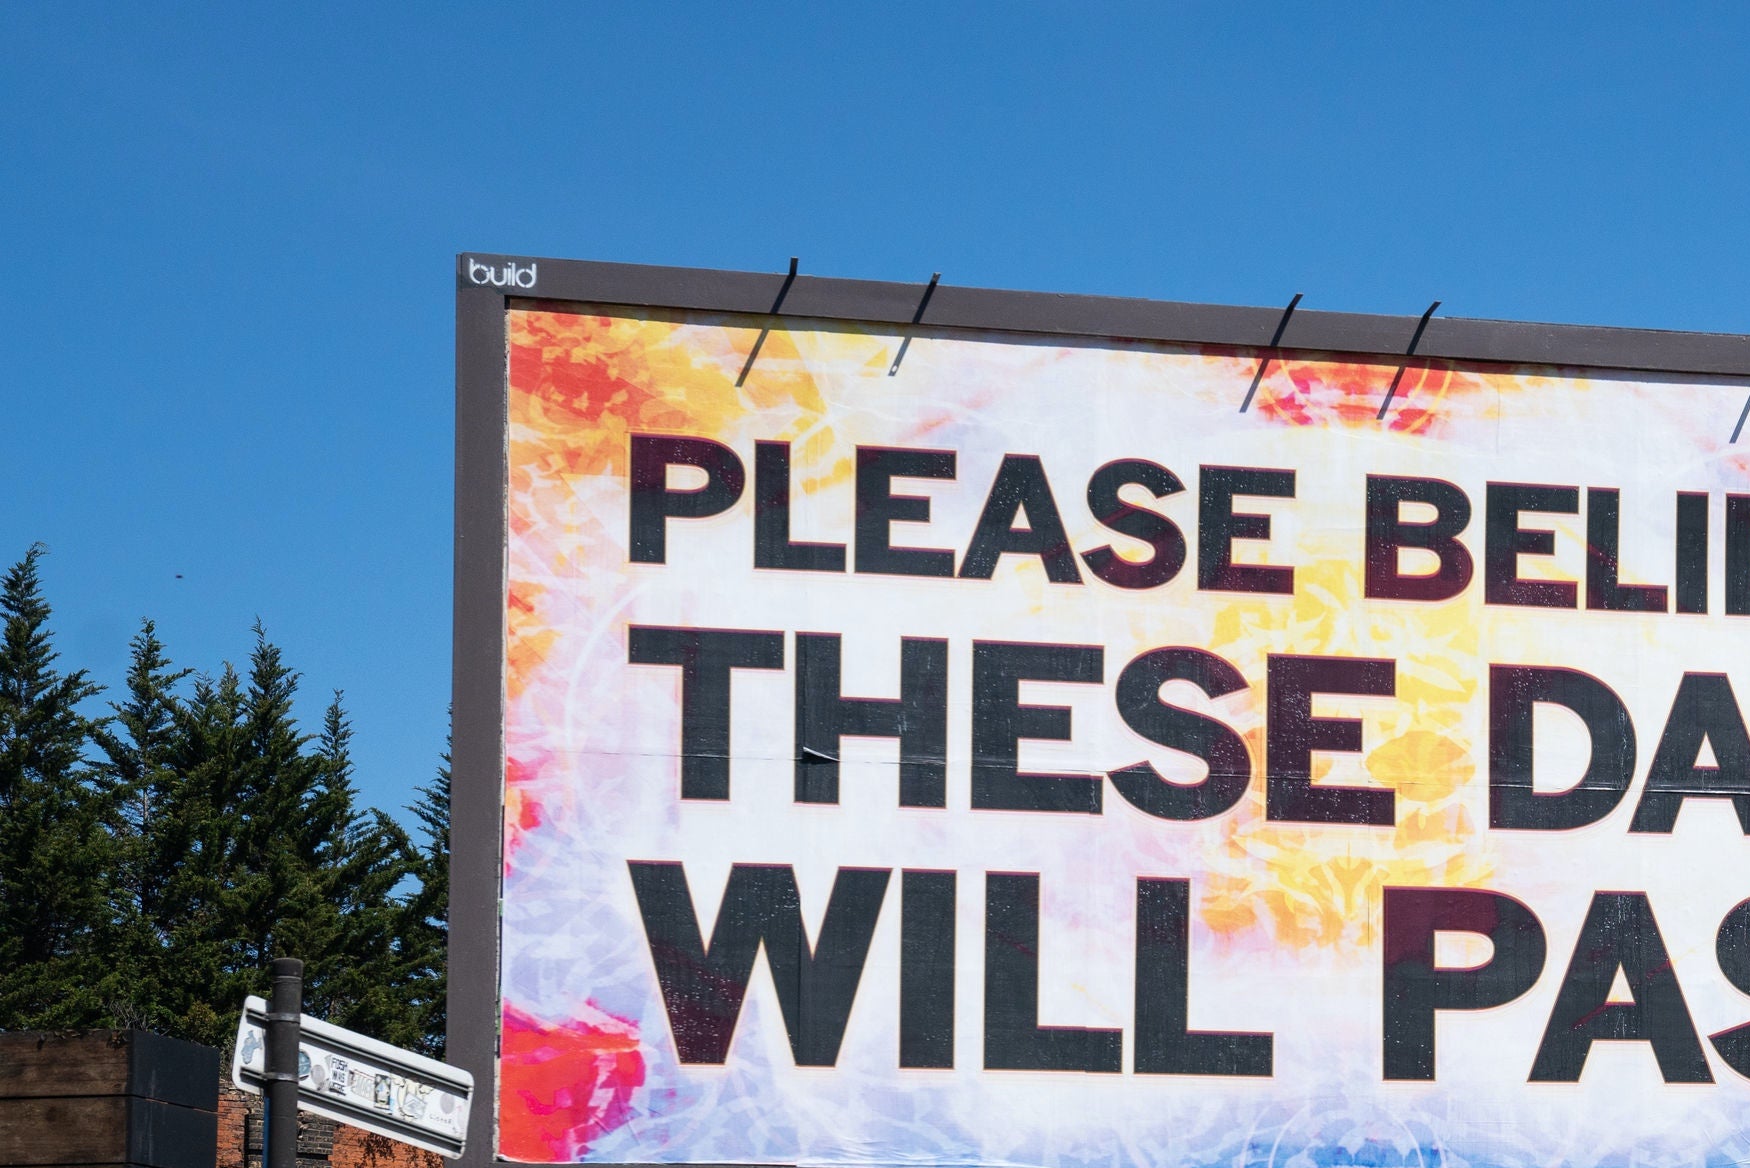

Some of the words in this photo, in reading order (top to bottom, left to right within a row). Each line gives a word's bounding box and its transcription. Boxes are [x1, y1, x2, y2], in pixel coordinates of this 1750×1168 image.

[468, 258, 537, 288] build
[630, 436, 1295, 593] PLEASE
[629, 628, 1394, 825] THESE
[629, 863, 1272, 1076] WILL
